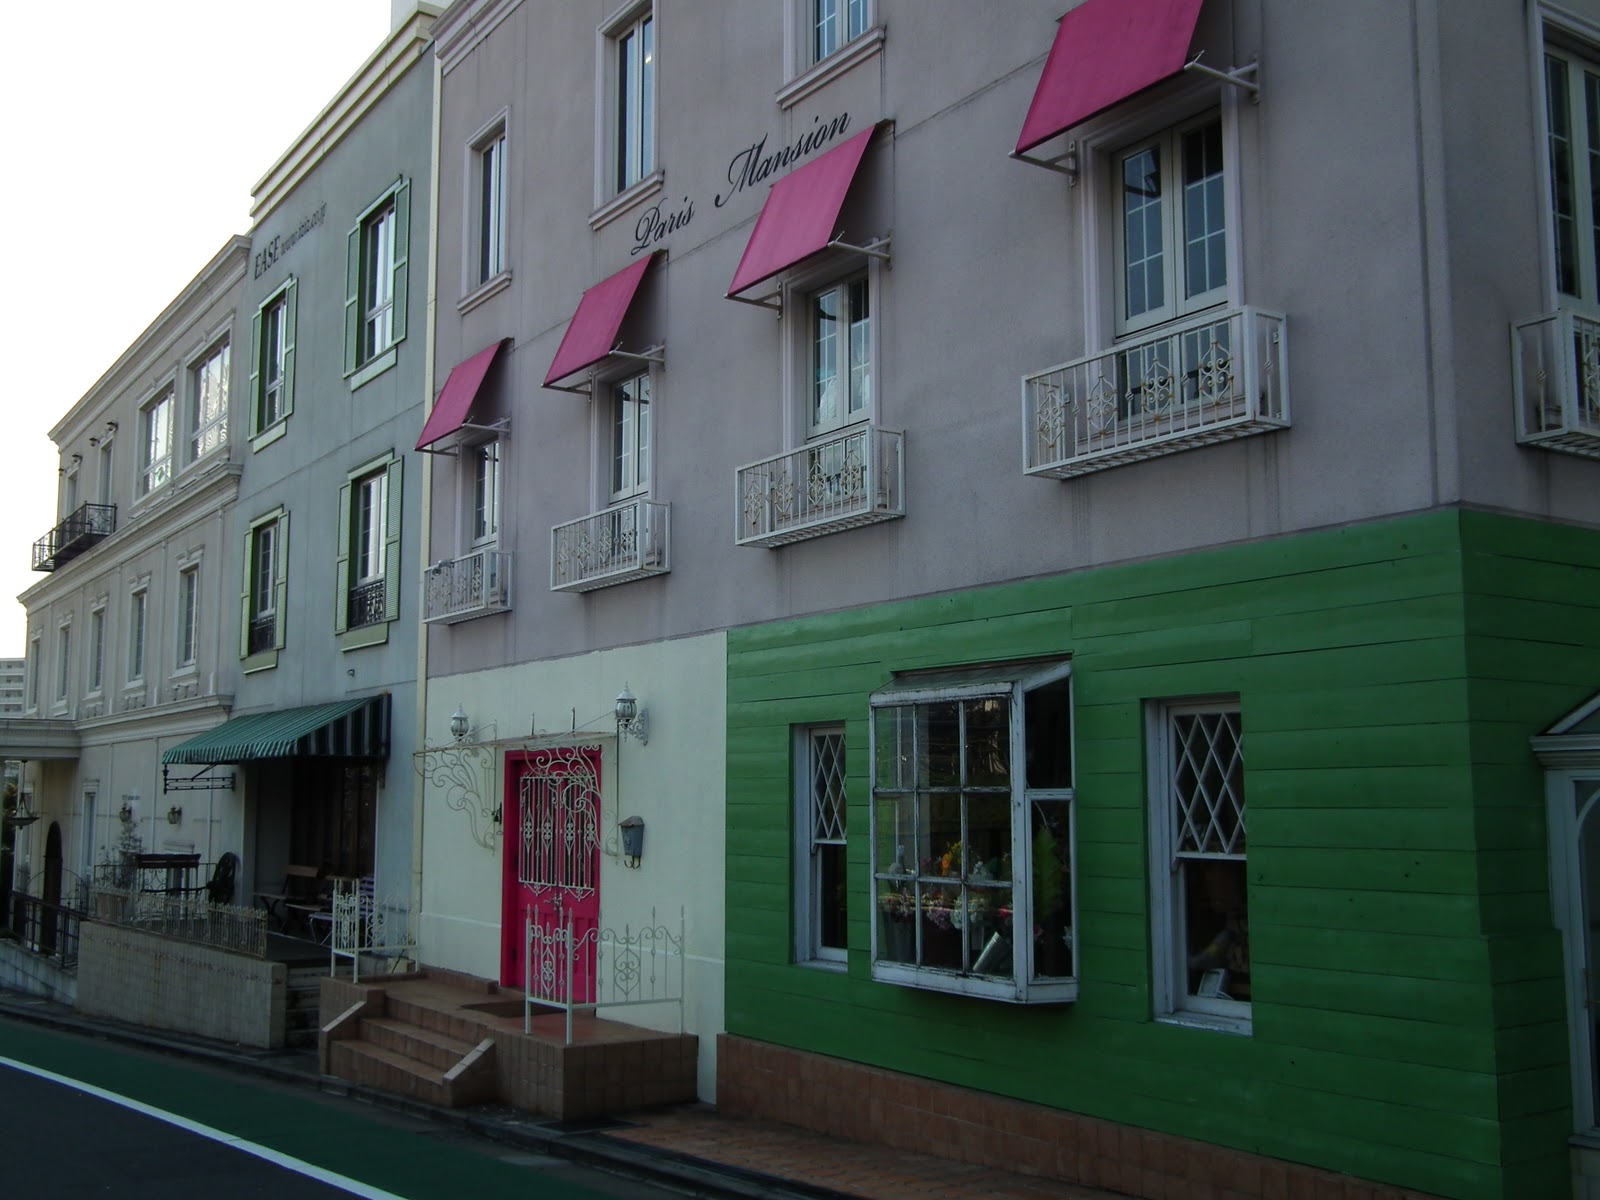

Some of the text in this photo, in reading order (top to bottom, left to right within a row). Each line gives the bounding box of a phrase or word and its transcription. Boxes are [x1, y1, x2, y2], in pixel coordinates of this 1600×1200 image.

[631, 112, 850, 255] Paris Mansion
[255, 235, 280, 280] EASE
